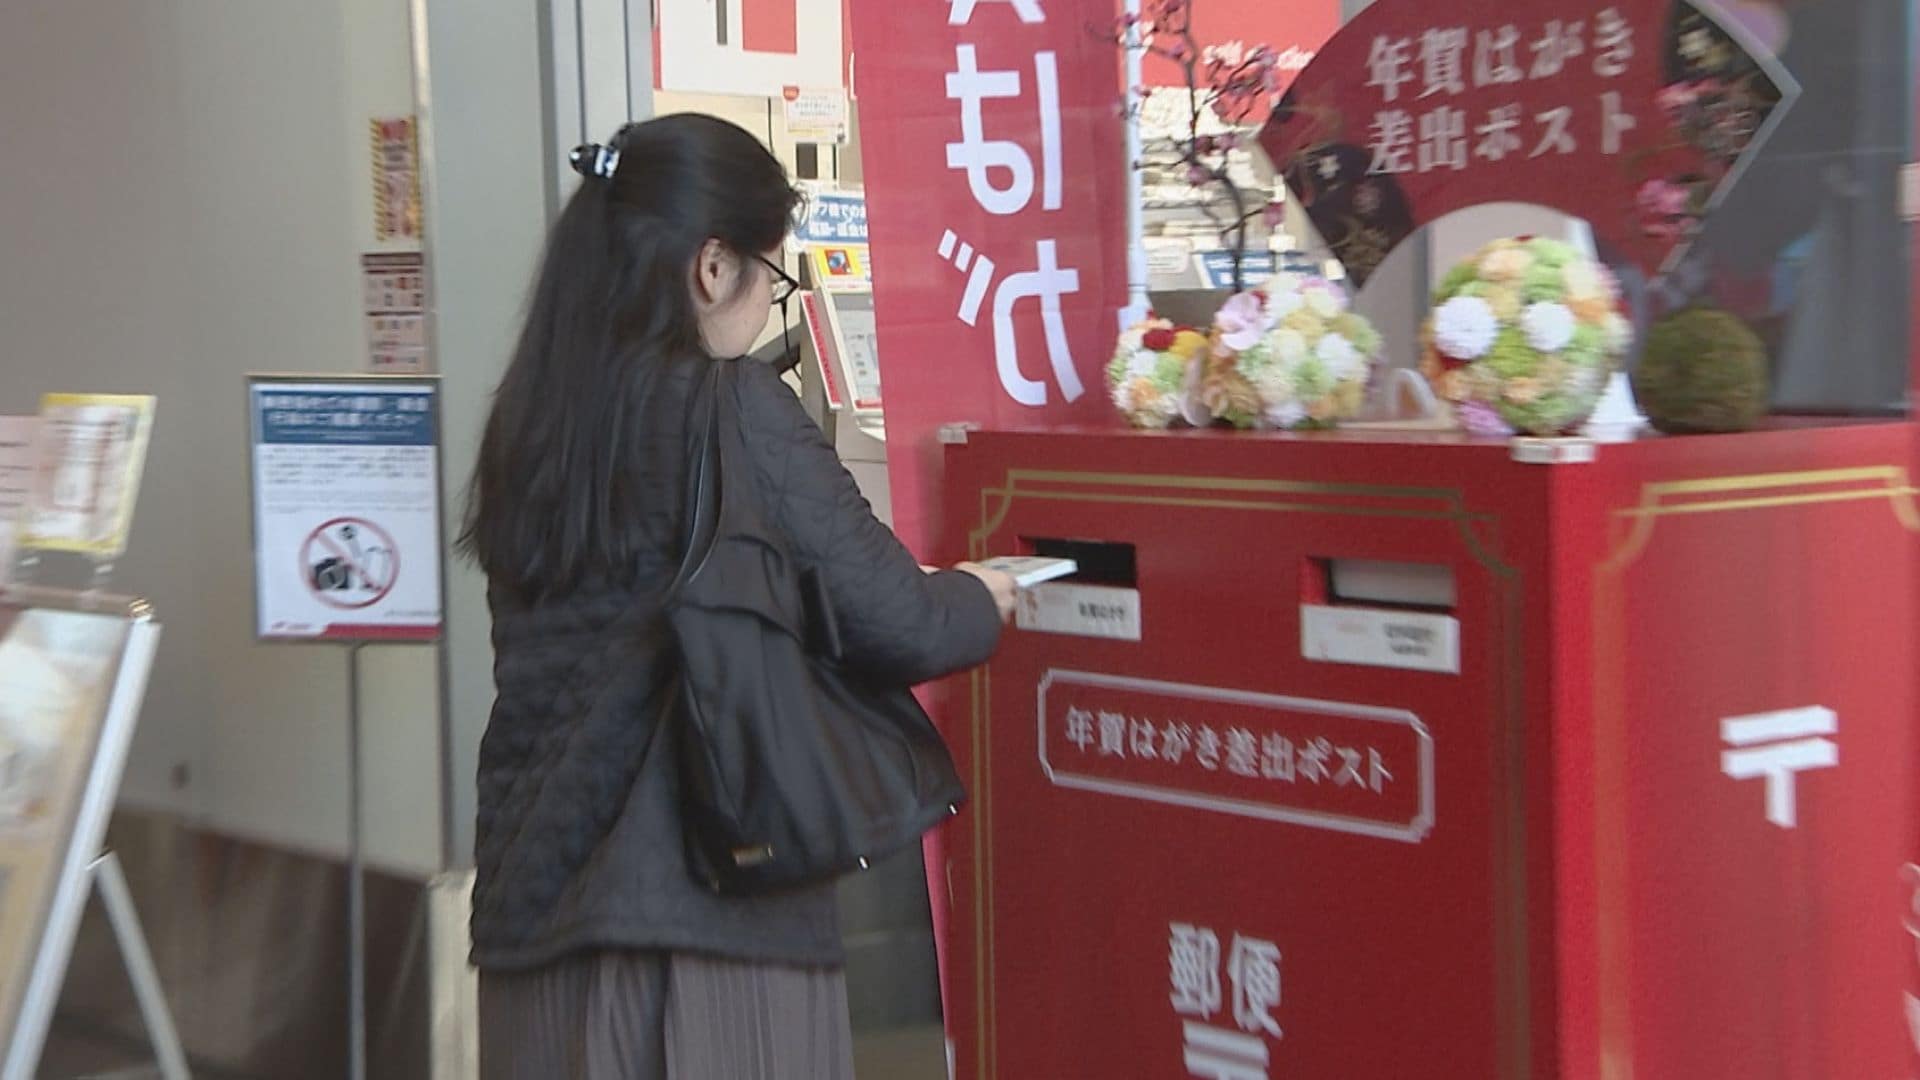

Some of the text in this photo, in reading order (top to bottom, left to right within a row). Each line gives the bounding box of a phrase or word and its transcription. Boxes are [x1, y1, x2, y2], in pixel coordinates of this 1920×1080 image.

[1364, 7, 1635, 101] 年賀はがき
[1364, 90, 1637, 176] 差出ポスト
[1065, 704, 1394, 795] 年賀はがき差出ポスト
[1168, 921, 1284, 1039] 郵便
